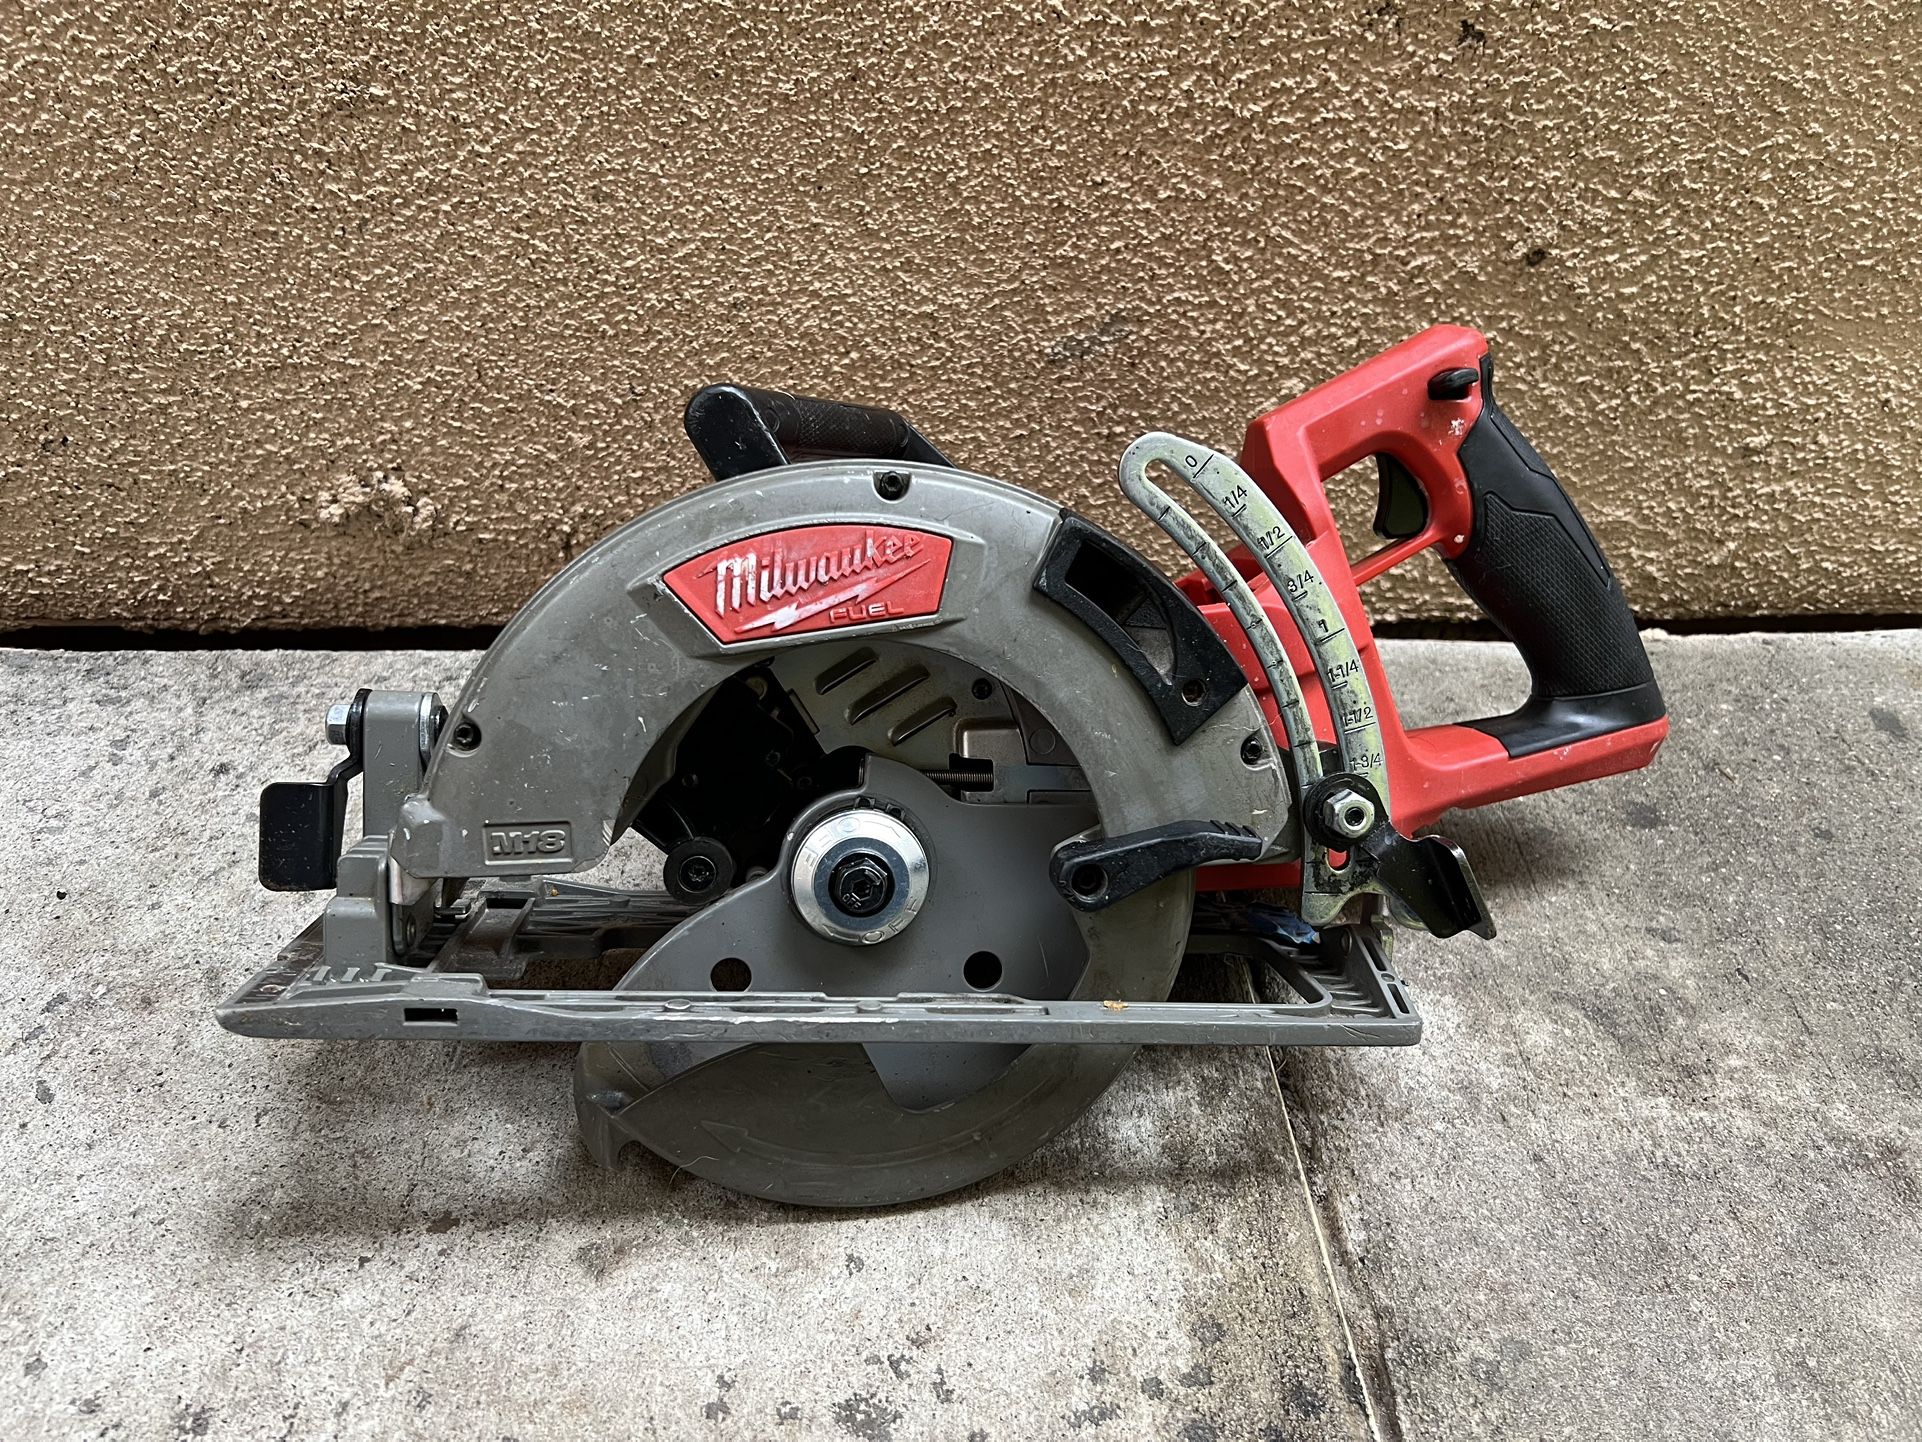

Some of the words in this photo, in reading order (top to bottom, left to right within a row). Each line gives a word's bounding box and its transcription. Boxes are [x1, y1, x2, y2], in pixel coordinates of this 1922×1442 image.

[1185, 455, 1198, 468] 0
[1223, 485, 1248, 508] 1/4
[1257, 526, 1286, 550] 1/2
[693, 529, 925, 618] Milwaukee
[1287, 570, 1314, 593] 3/4
[829, 601, 905, 623] FUEL
[1317, 618, 1329, 634] 1
[1326, 659, 1359, 683] 1-1/4
[1350, 752, 1384, 771] 1-3/4
[491, 829, 567, 855] M18
[841, 893, 861, 910] OFF
[861, 896, 917, 944] OFF
